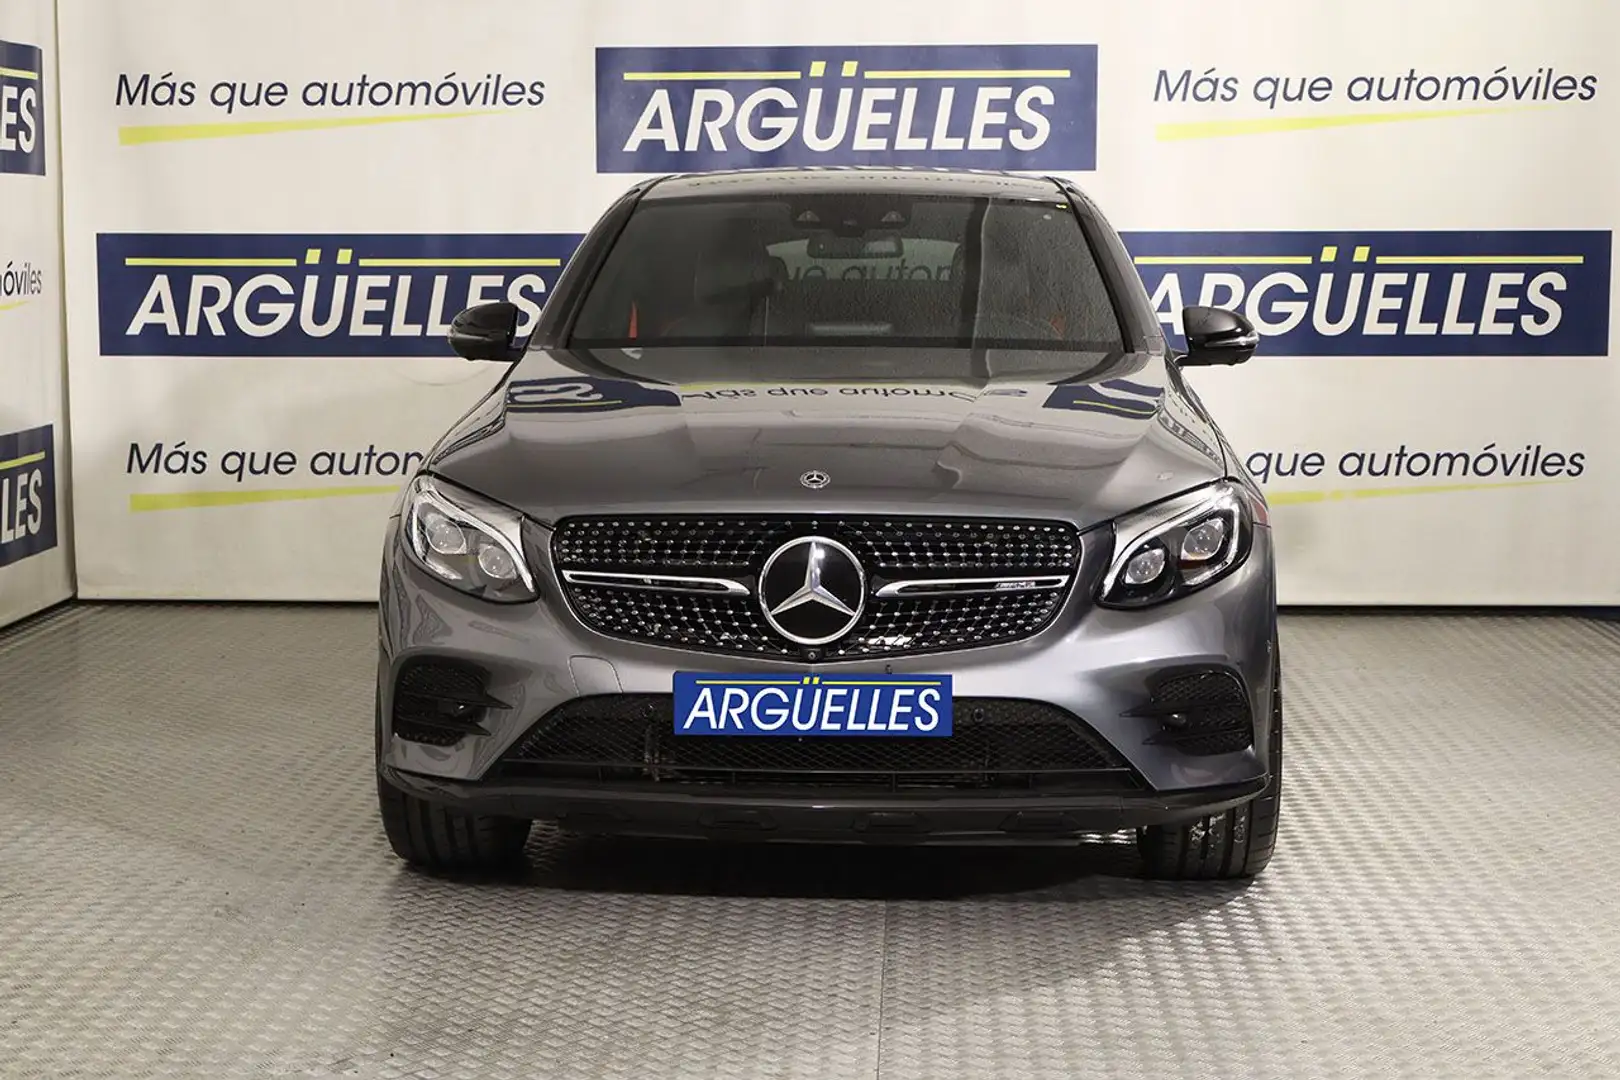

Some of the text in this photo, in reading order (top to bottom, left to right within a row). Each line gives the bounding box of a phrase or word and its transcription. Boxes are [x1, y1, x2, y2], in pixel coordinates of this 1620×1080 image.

[115, 72, 545, 115] Más que automóviles
[622, 61, 1055, 152] ARGÜELLES
[1154, 66, 1598, 109] Más que automóviles
[0, 260, 42, 296] óviles
[1149, 246, 1568, 337] ARGÜELLES
[126, 440, 208, 475] Más
[220, 450, 297, 483] que
[1246, 442, 1586, 484] que automóviles
[683, 677, 941, 731] ARGÜELLES
